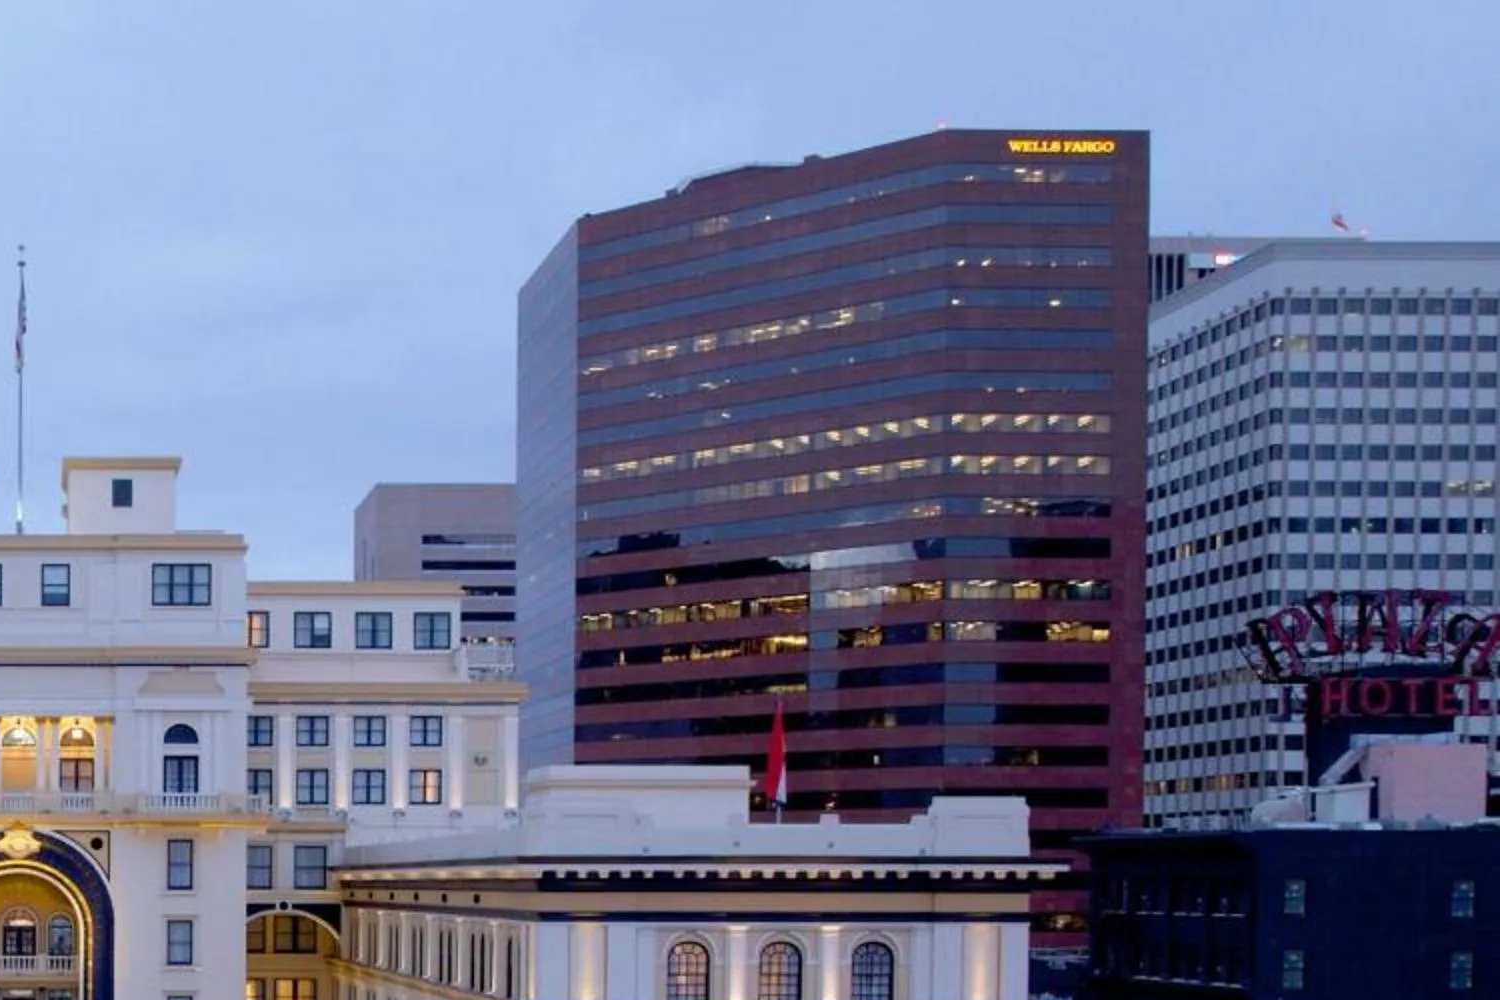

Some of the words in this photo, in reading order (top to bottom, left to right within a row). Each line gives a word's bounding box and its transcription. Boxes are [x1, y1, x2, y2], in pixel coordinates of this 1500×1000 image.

[1007, 140, 1061, 153] WELLS
[1063, 140, 1116, 153] FARGO
[1320, 675, 1494, 717] HOTEL
